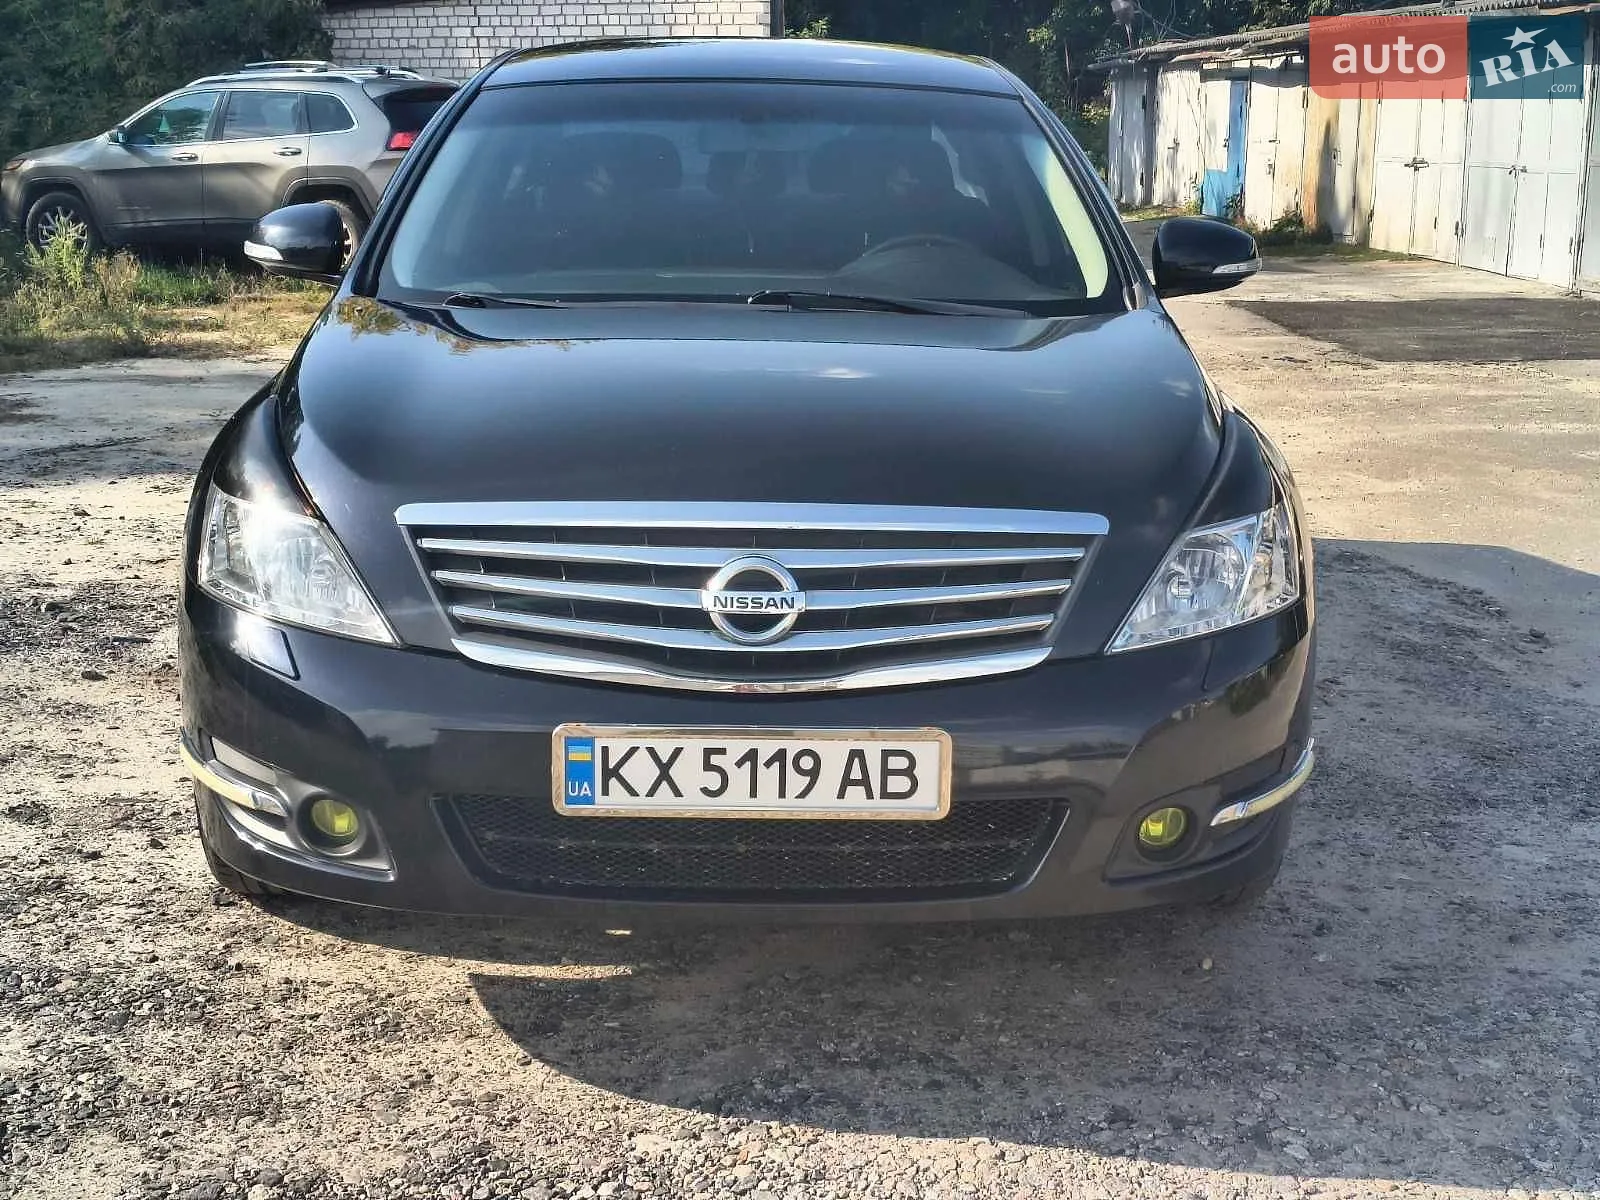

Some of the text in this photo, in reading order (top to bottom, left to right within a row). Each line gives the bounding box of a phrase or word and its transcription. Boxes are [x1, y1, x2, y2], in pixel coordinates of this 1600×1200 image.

[713, 595, 795, 610] NISSAN
[601, 746, 919, 800] KX 5119 AB
[568, 783, 592, 797] UA
